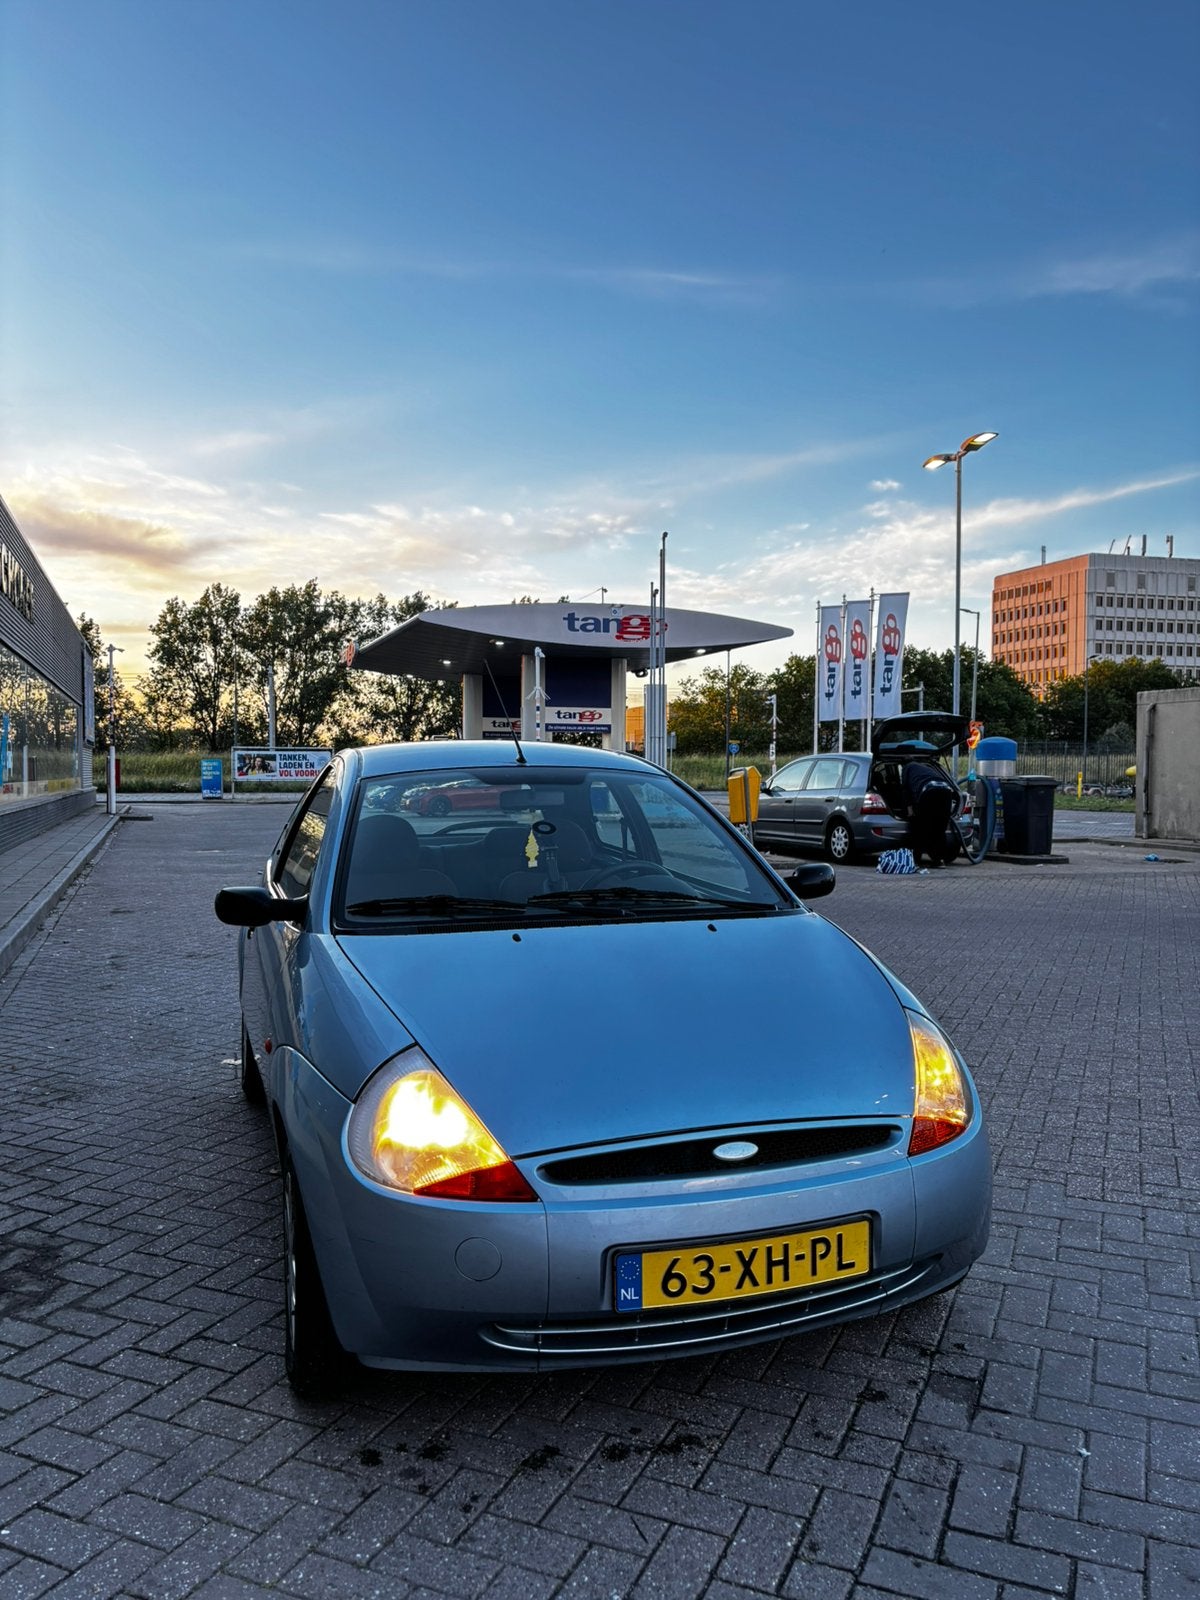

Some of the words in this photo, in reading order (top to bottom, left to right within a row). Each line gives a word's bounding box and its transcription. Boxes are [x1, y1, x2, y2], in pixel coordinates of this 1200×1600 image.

[562, 612, 668, 642] tango
[824, 624, 842, 702] tango
[851, 618, 868, 700] tango
[880, 613, 901, 697] tango
[555, 710, 603, 723] tango
[278, 753, 310, 762] TANKEN,
[279, 761, 303, 769] LADEN
[279, 769, 294, 777] VOL
[661, 1233, 856, 1298] 63-XH-PL
[620, 1287, 639, 1301] NL
